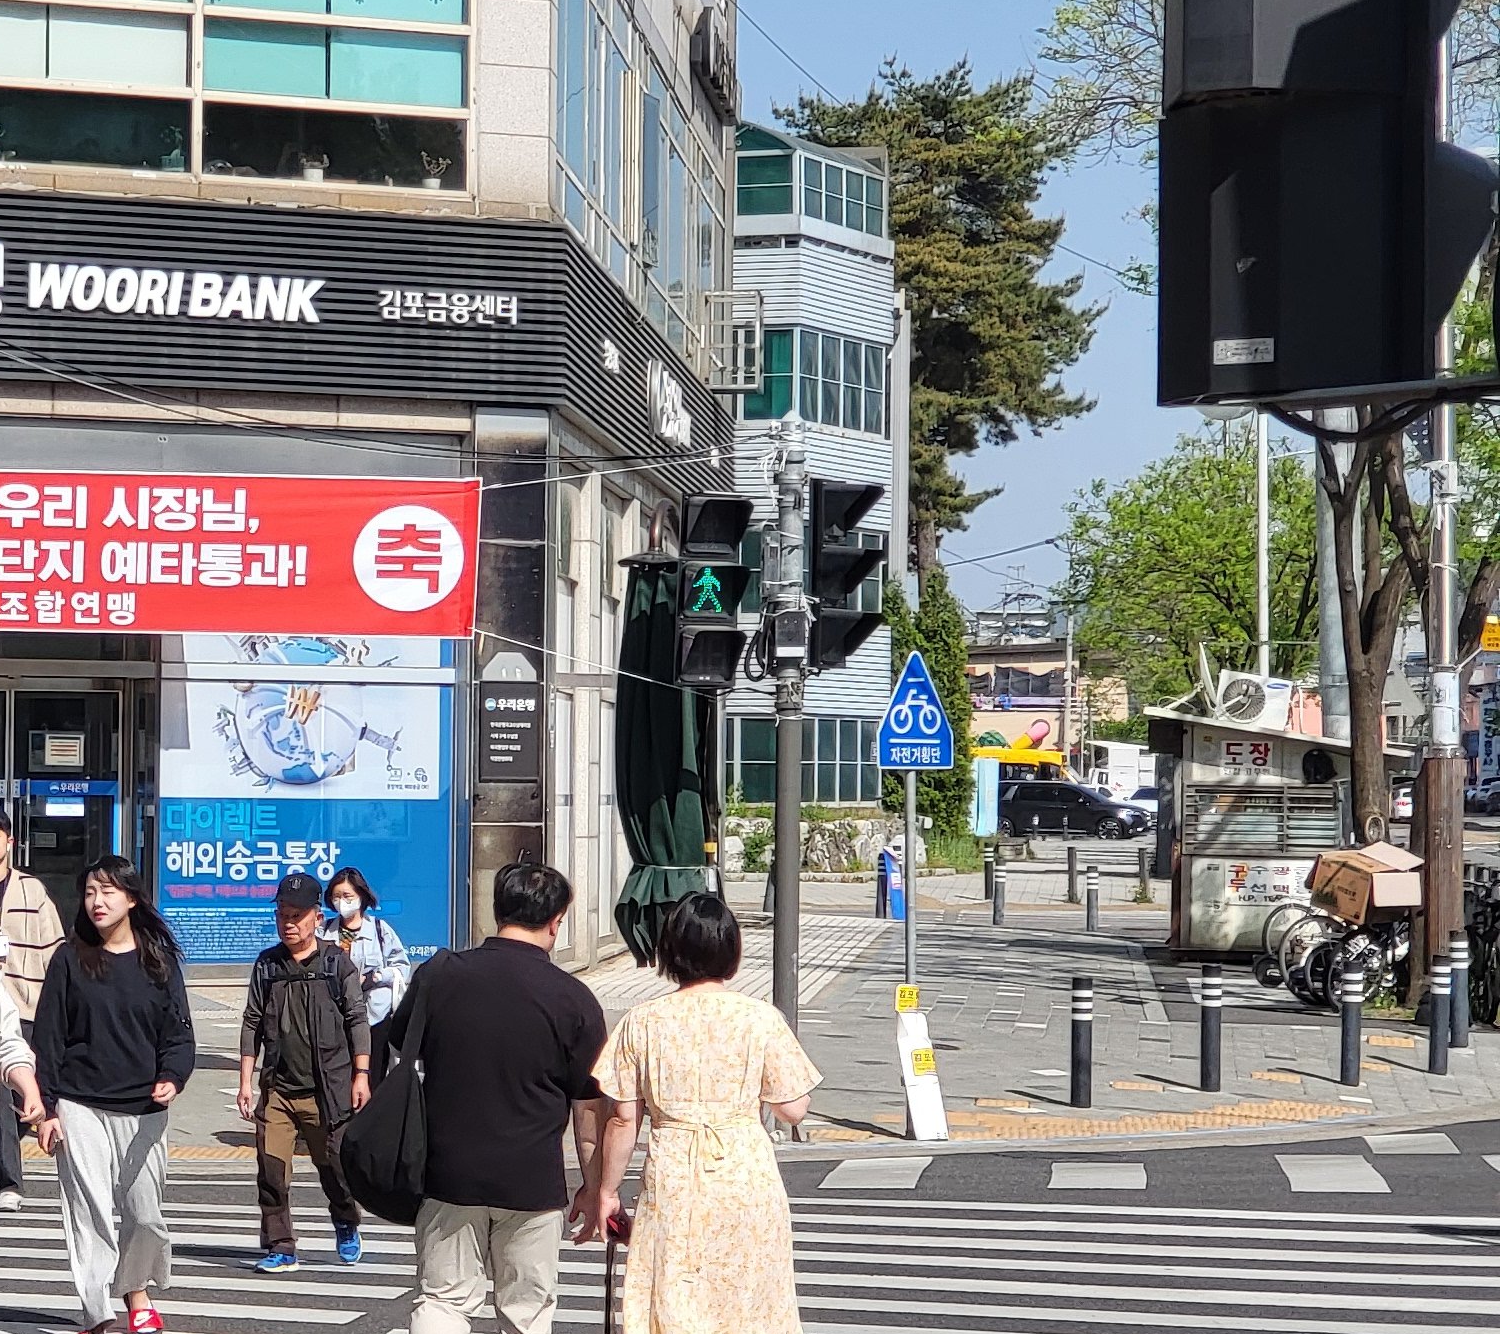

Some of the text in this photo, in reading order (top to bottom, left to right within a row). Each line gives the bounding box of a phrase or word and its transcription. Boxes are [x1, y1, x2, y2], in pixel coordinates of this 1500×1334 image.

[28, 260, 190, 317] WOORI
[190, 268, 326, 324] BANK
[378, 289, 520, 326] 김포금융센터
[103, 486, 260, 536] 시장님,
[100, 537, 308, 589] 예타통과!
[375, 526, 443, 597] 축
[497, 699, 536, 712] 우리은행
[889, 746, 941, 764] 자전거횡단
[1225, 743, 1271, 767] 도장
[60, 782, 89, 793] 우리은행
[166, 802, 281, 841] 다이렉트
[165, 840, 341, 881] 해외송금통장
[409, 945, 438, 957] 우리은행
